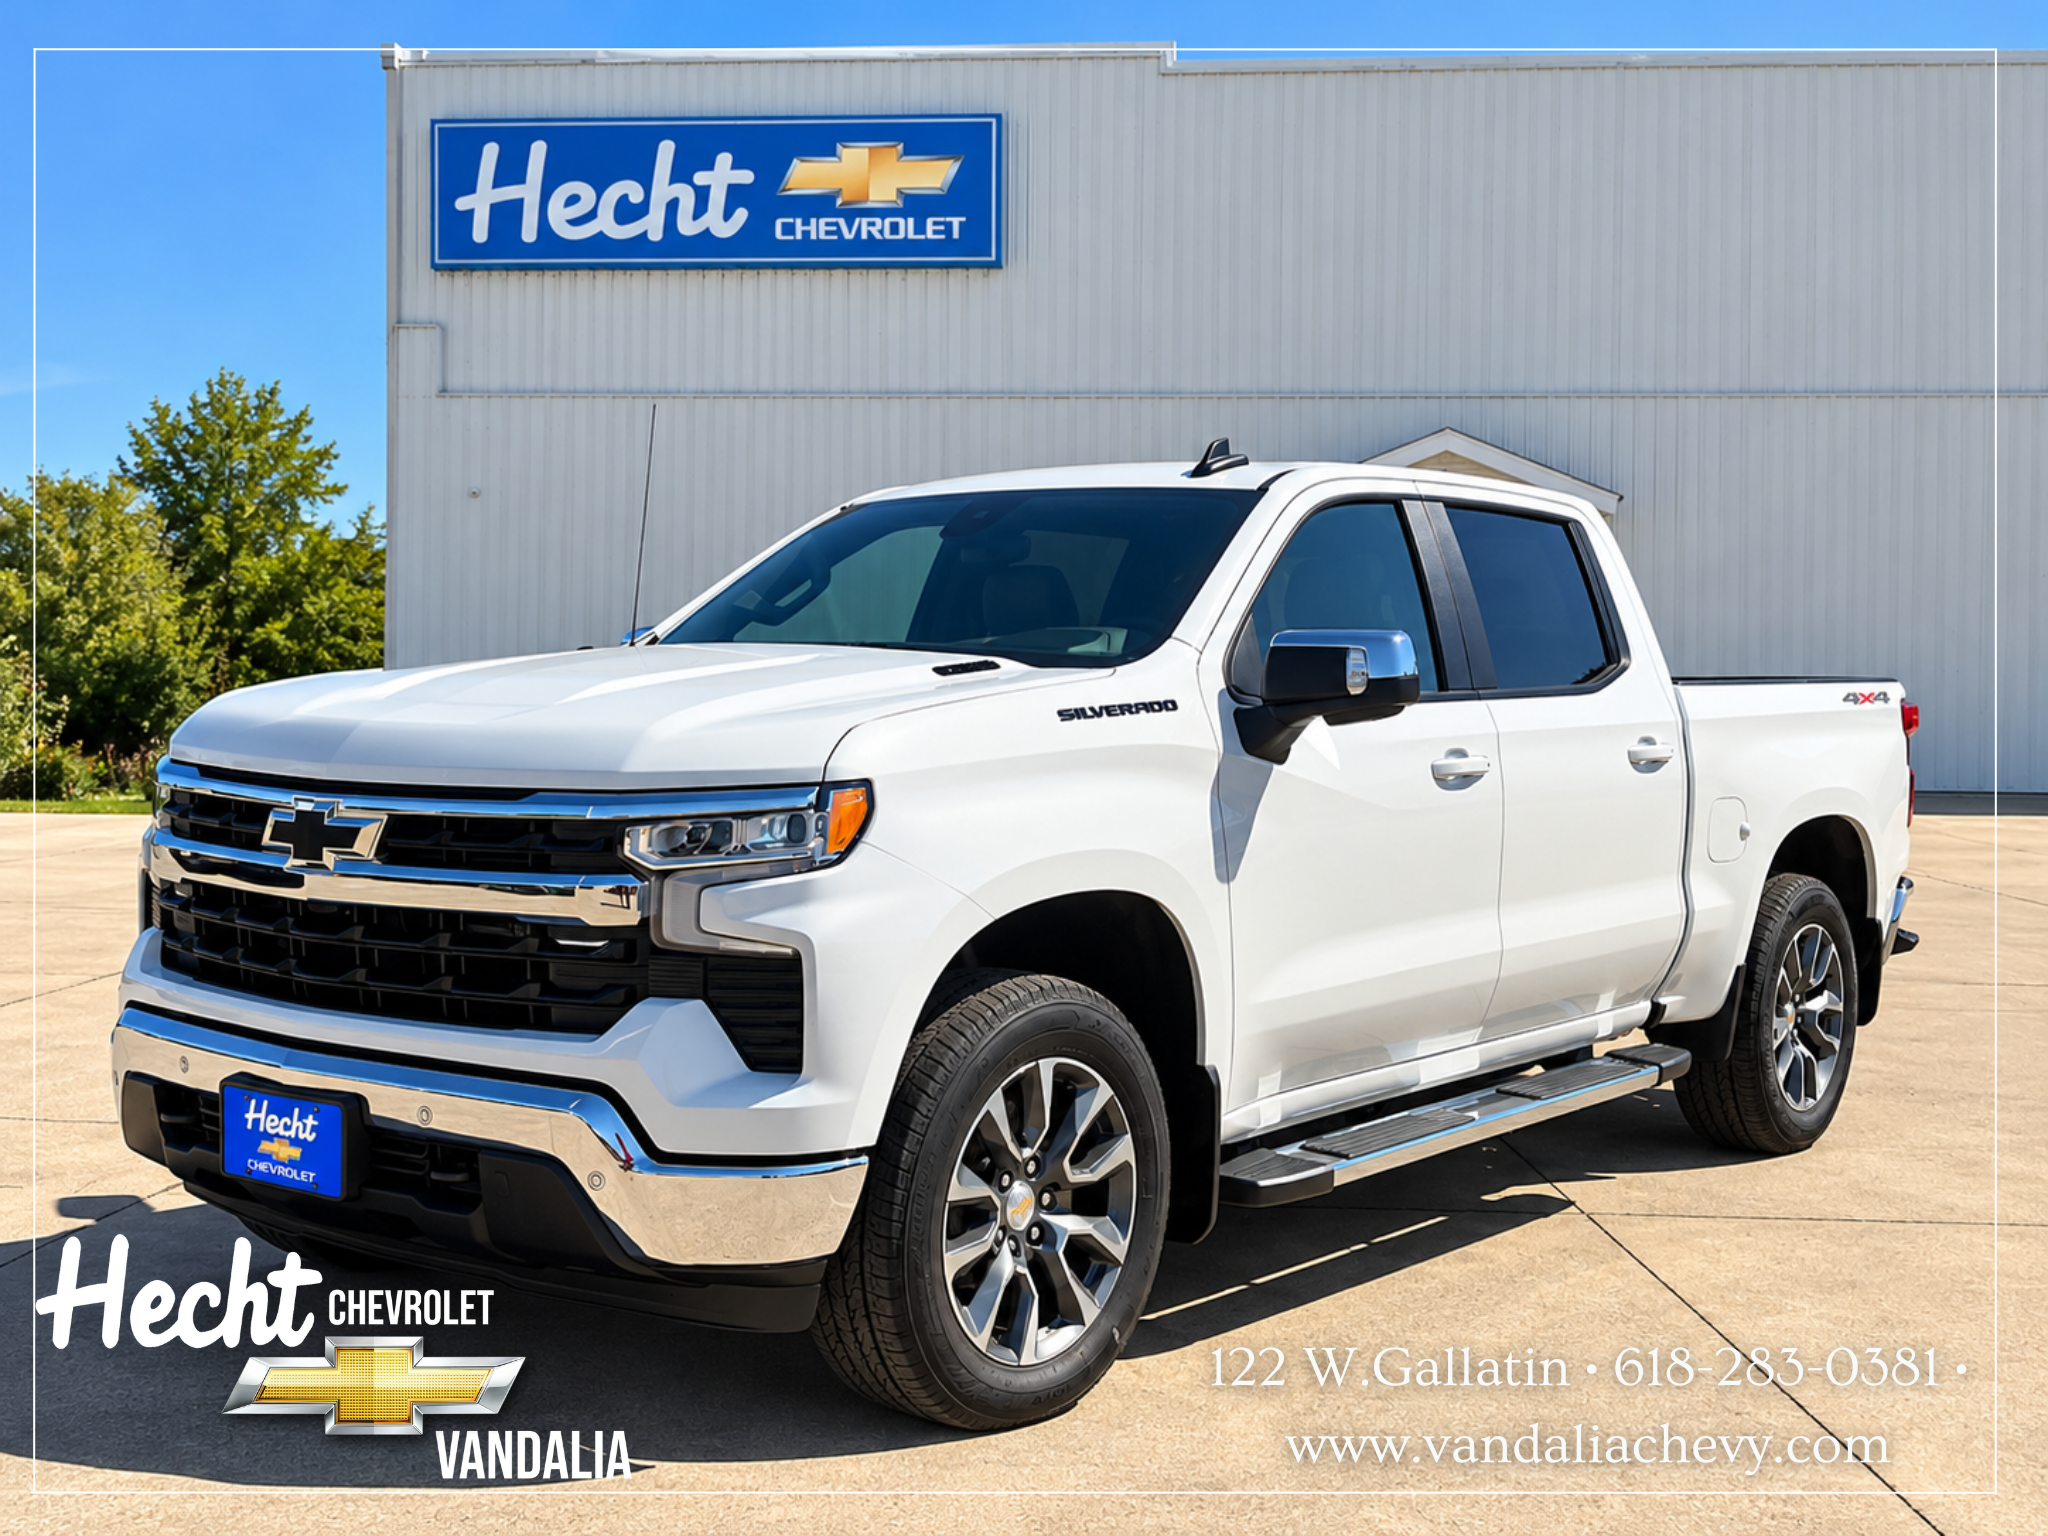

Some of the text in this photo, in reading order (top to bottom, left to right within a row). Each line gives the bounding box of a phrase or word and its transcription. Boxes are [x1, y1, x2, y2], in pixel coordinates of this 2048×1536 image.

[455, 139, 755, 243] Hecht
[775, 216, 967, 240] CHEVROLET
[1057, 699, 1178, 722] SILVERADO
[244, 1098, 319, 1142] Hecht
[247, 1158, 316, 1183] CHEVROLET
